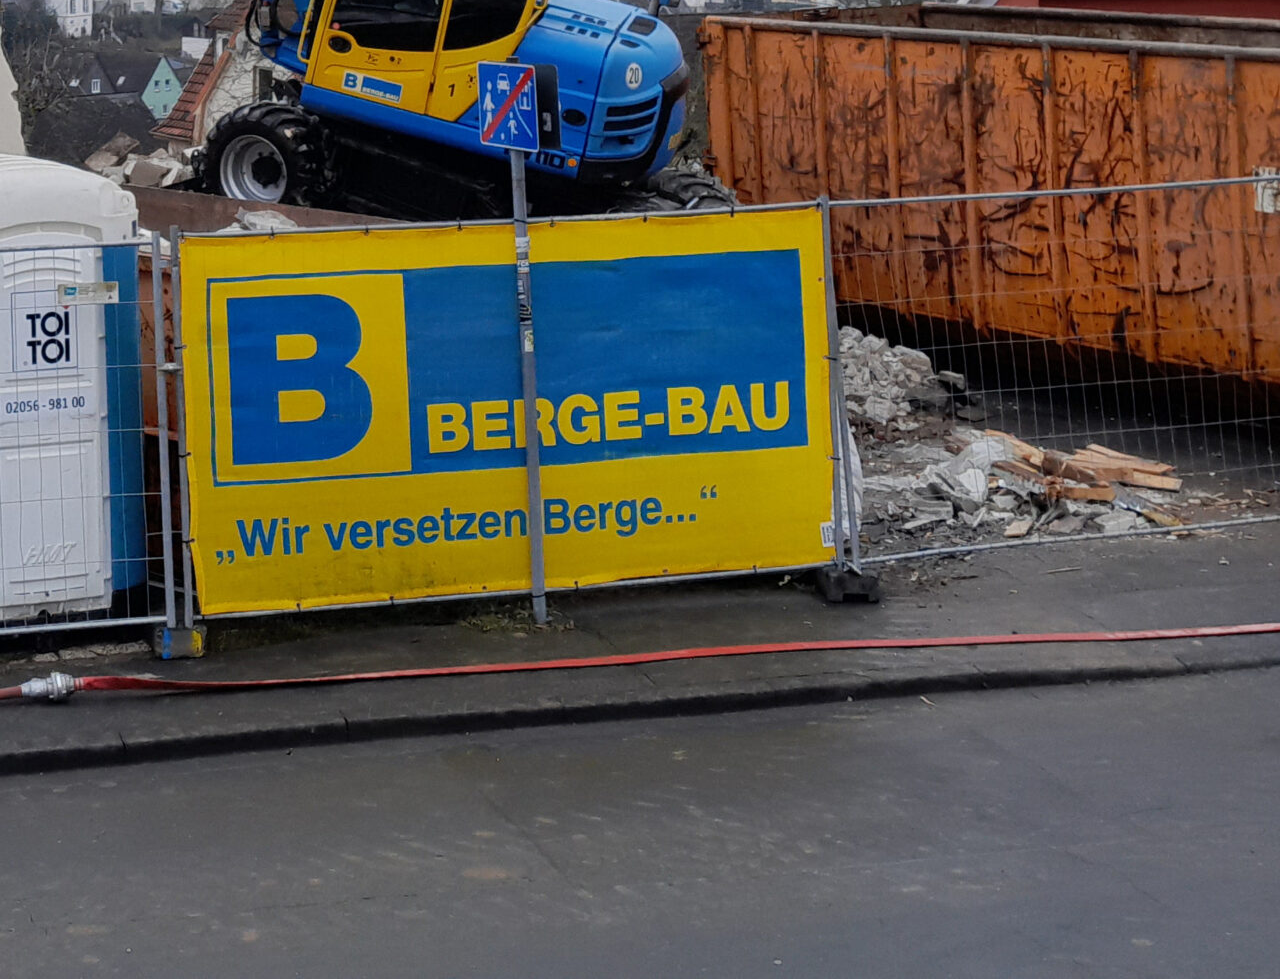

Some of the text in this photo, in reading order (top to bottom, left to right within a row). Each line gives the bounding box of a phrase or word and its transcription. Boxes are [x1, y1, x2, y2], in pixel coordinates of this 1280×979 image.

[343, 72, 358, 89] B
[629, 67, 640, 85] 20
[25, 311, 70, 338] TOI
[26, 338, 71, 365] TOI
[226, 293, 373, 466] B
[5, 400, 40, 414] 02056
[48, 398, 68, 411] 981
[72, 396, 85, 408] 00
[427, 381, 791, 454] BERGE-BAU
[323, 507, 528, 551] versetzen
